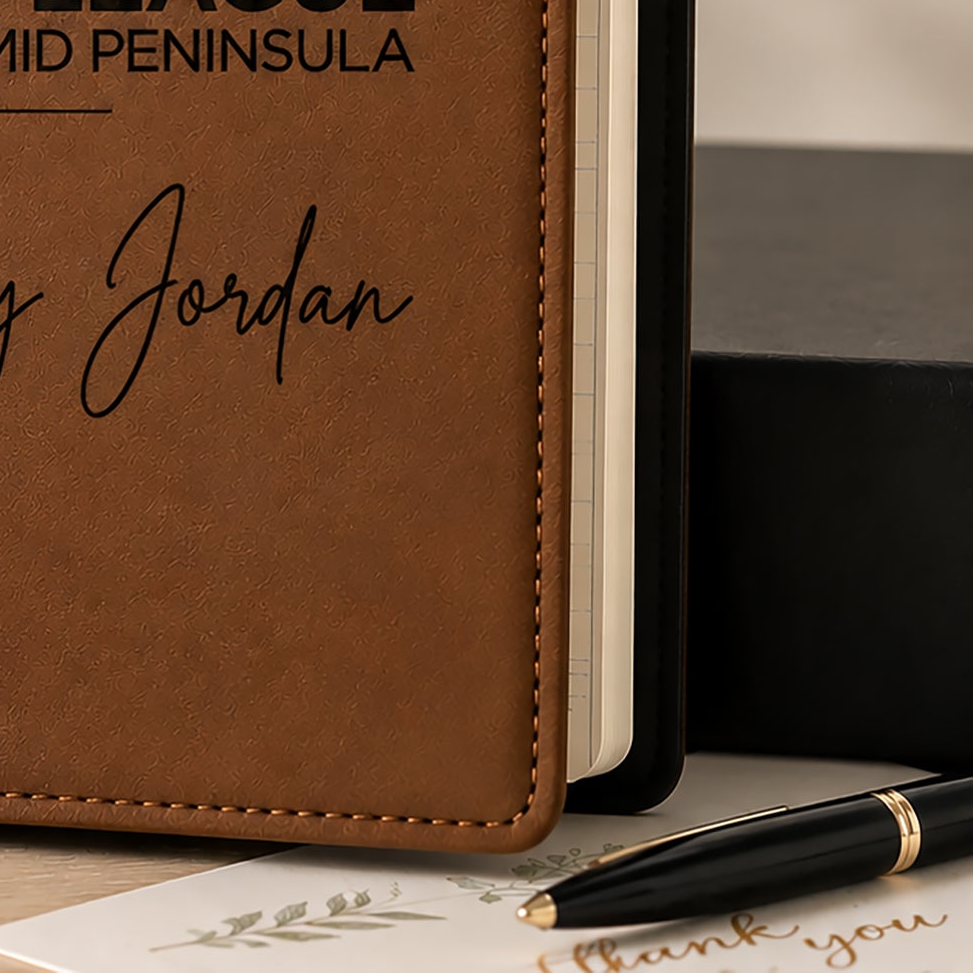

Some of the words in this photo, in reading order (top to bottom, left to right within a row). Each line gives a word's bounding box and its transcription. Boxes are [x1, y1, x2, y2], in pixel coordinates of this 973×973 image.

[92, 28, 415, 73] PENINSULA
[80, 183, 413, 419] Jordan
[804, 914, 947, 969] you
